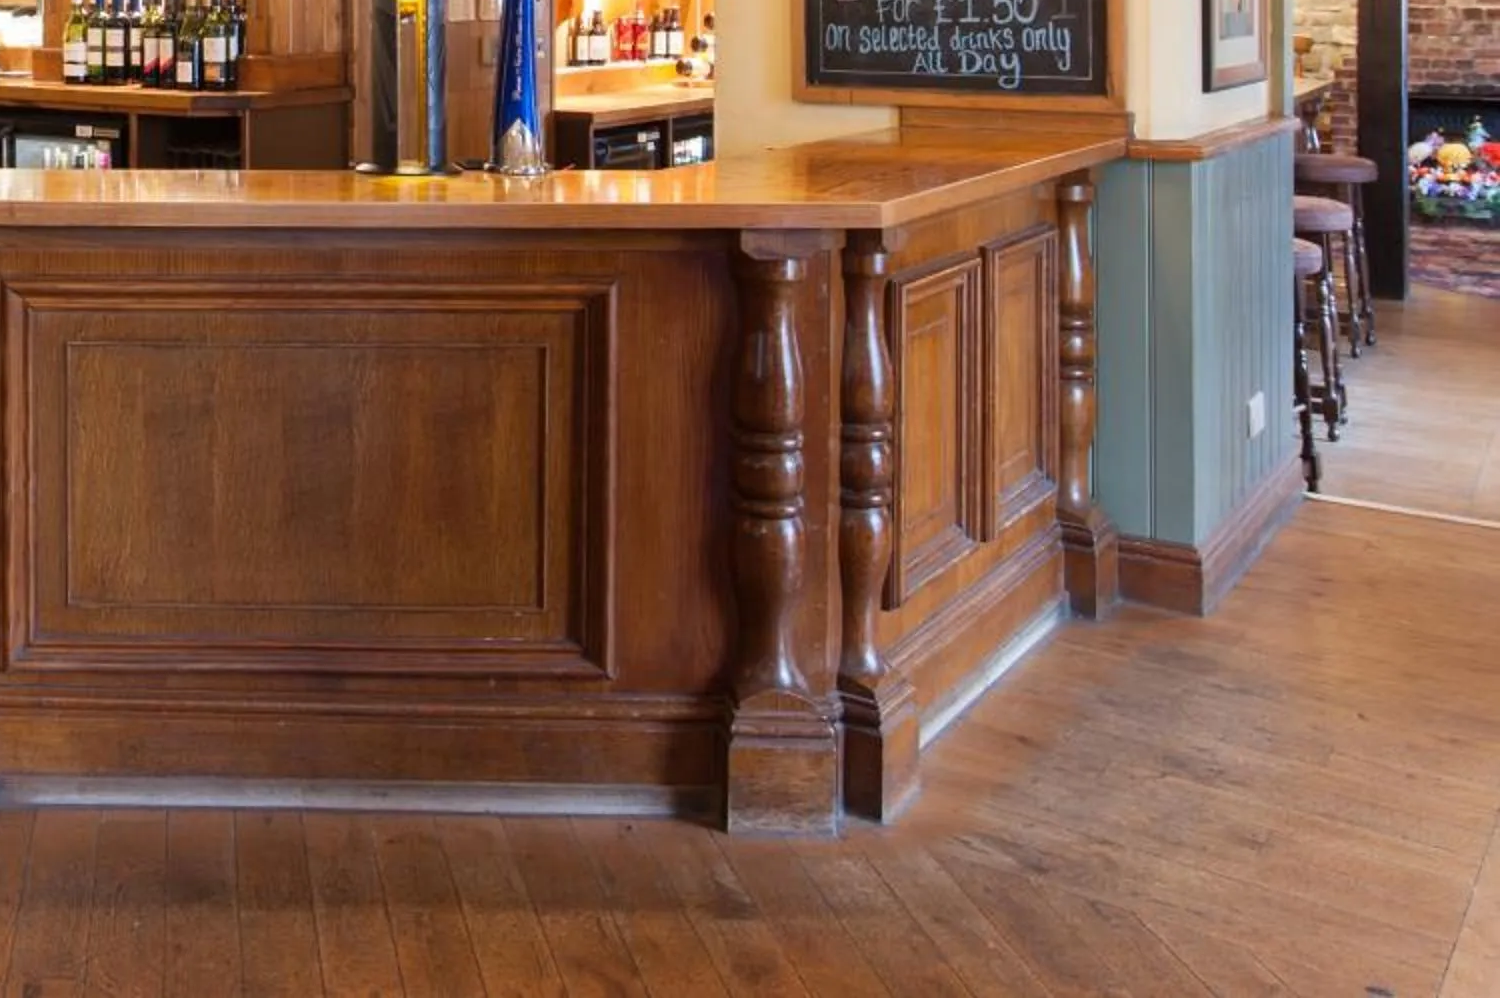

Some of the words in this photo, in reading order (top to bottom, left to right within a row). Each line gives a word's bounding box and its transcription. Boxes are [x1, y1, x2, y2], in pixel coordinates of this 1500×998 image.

[859, 25, 939, 54] selected
[950, 27, 1015, 52] drinks
[1022, 21, 1072, 71] only
[911, 52, 948, 75] All
[959, 52, 1021, 89] Day
